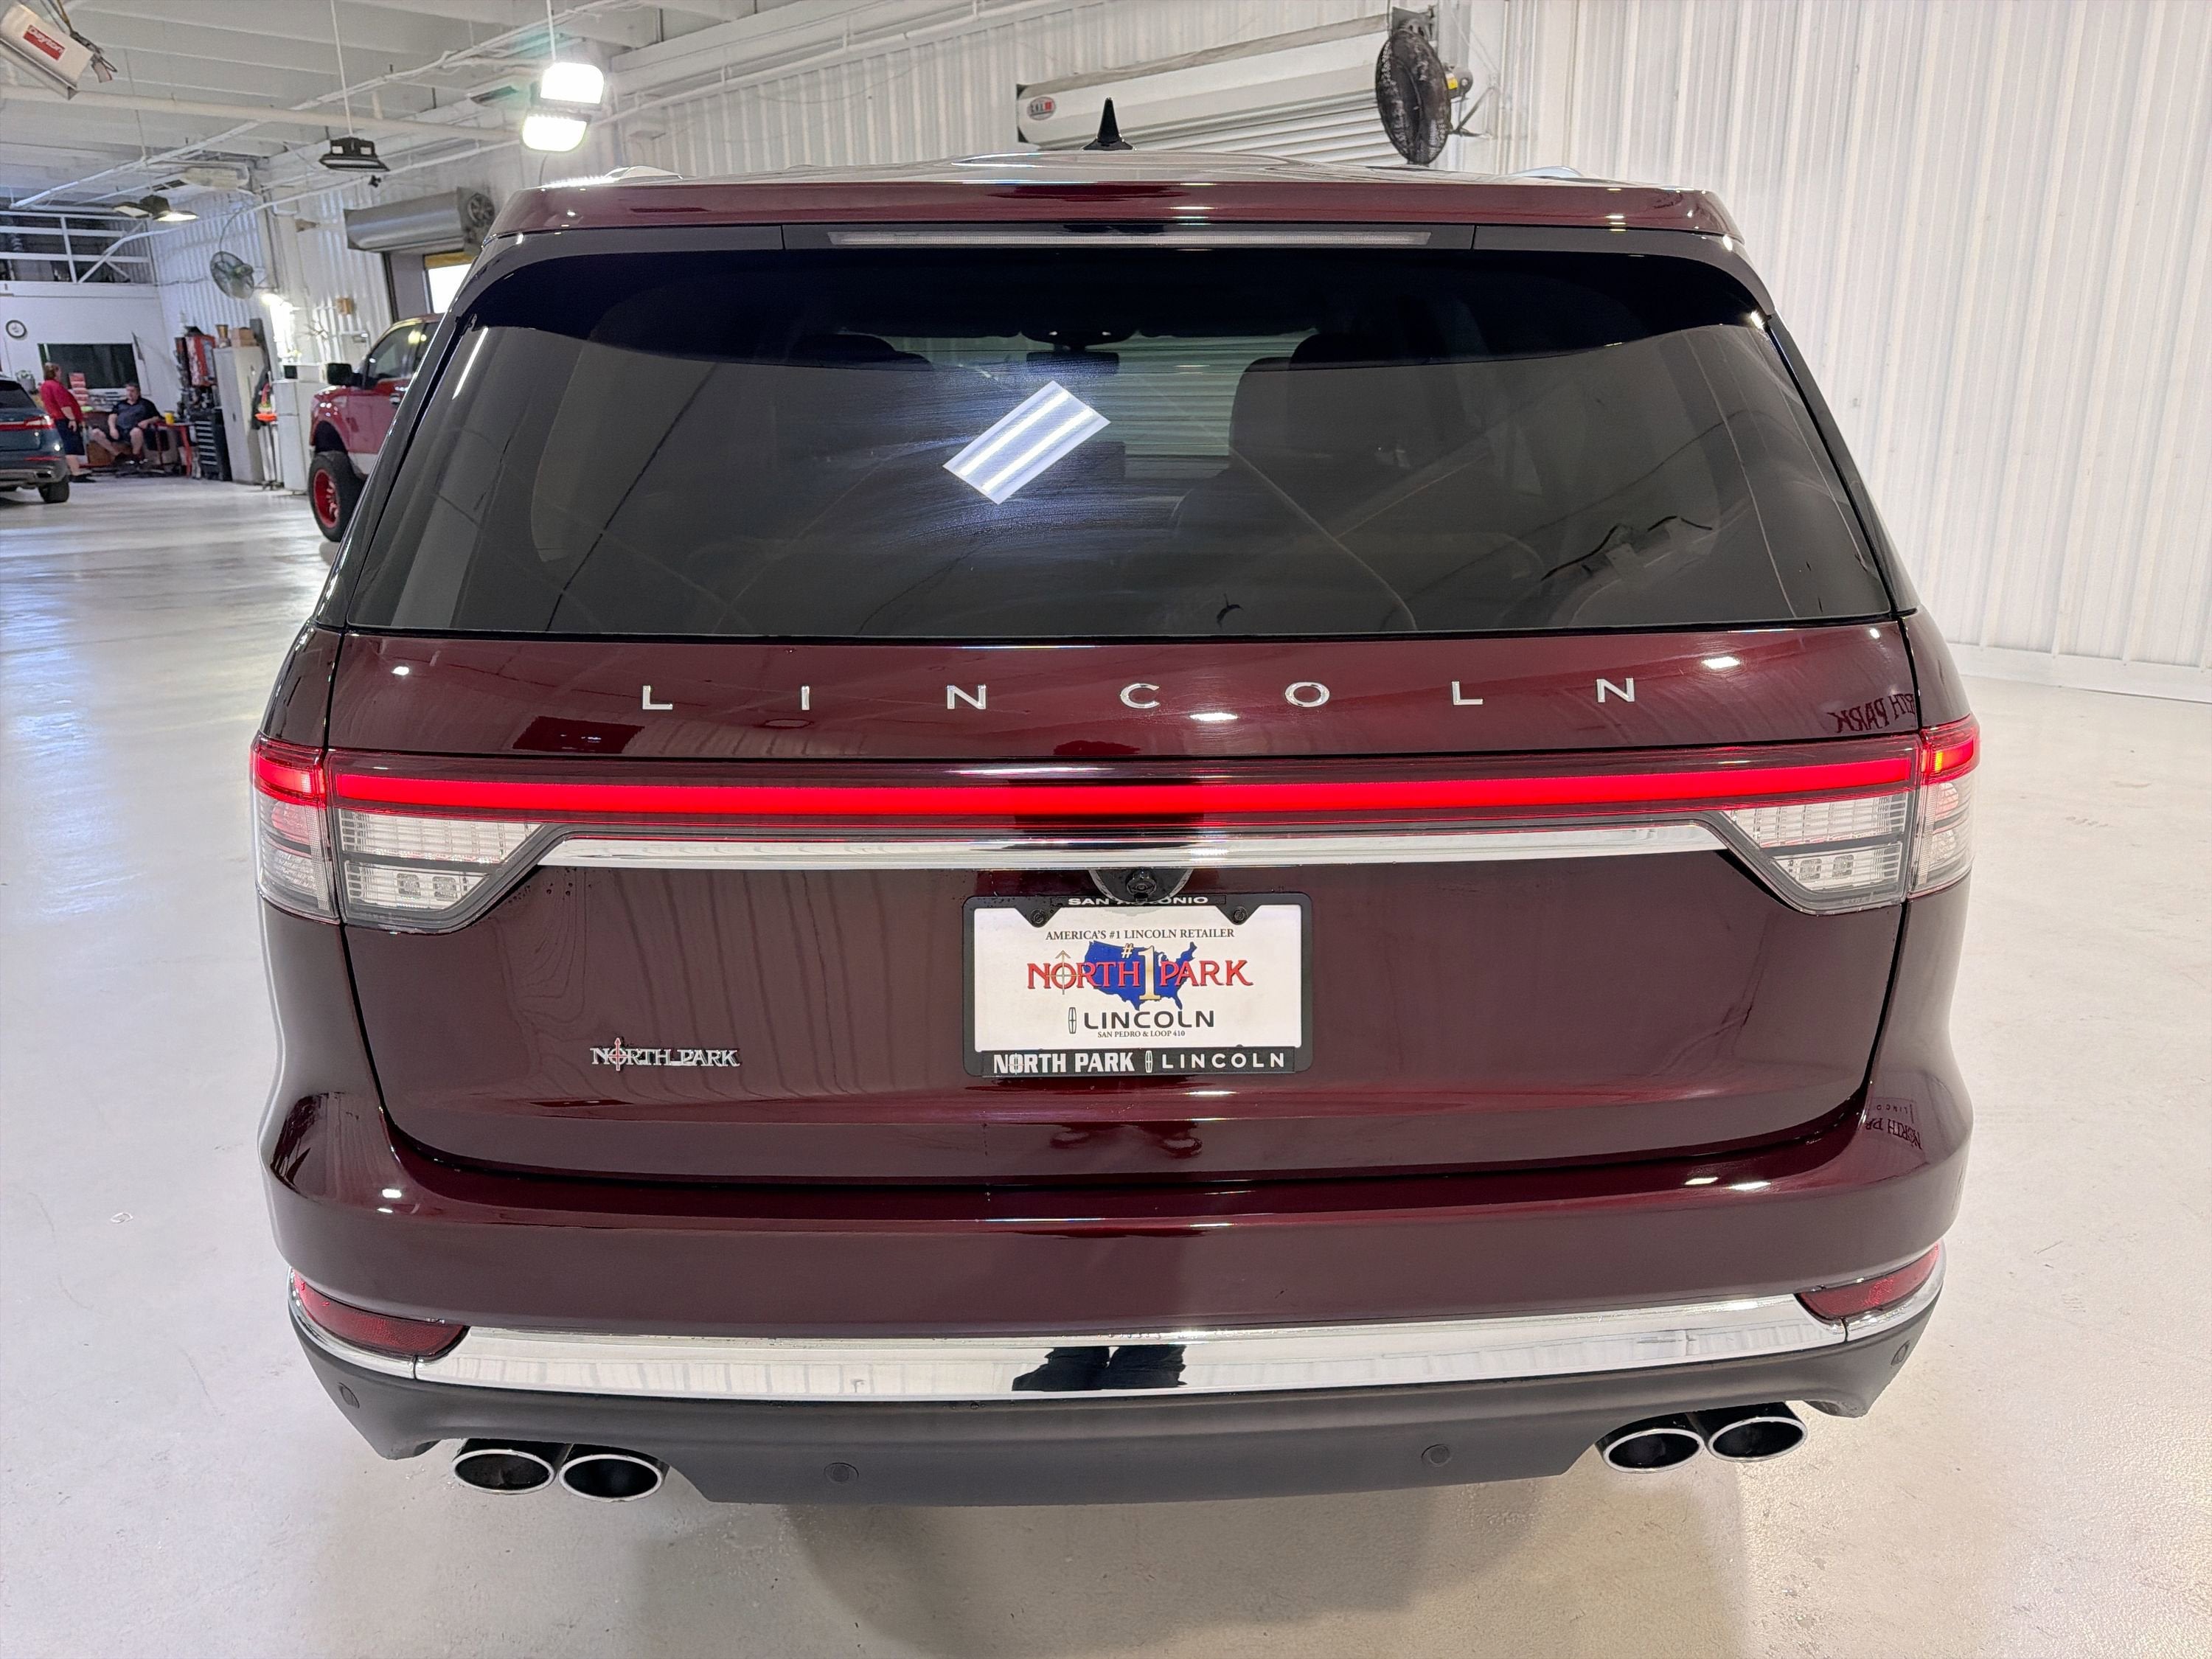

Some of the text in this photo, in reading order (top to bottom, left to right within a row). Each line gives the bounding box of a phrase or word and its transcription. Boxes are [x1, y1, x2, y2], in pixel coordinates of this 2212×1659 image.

[640, 677, 1635, 711] LINCOLN
[1068, 897, 1109, 905] SAN
[1046, 928, 1235, 941] AMERICA'S #1 LINCOLN RETAILER
[1027, 959, 1253, 990] NORTH PARK
[1084, 1010, 1214, 1029] LINCOLN
[590, 1046, 740, 1067] NORTH PARK
[993, 1051, 1284, 1074] NORTH PARK LINCOLN
